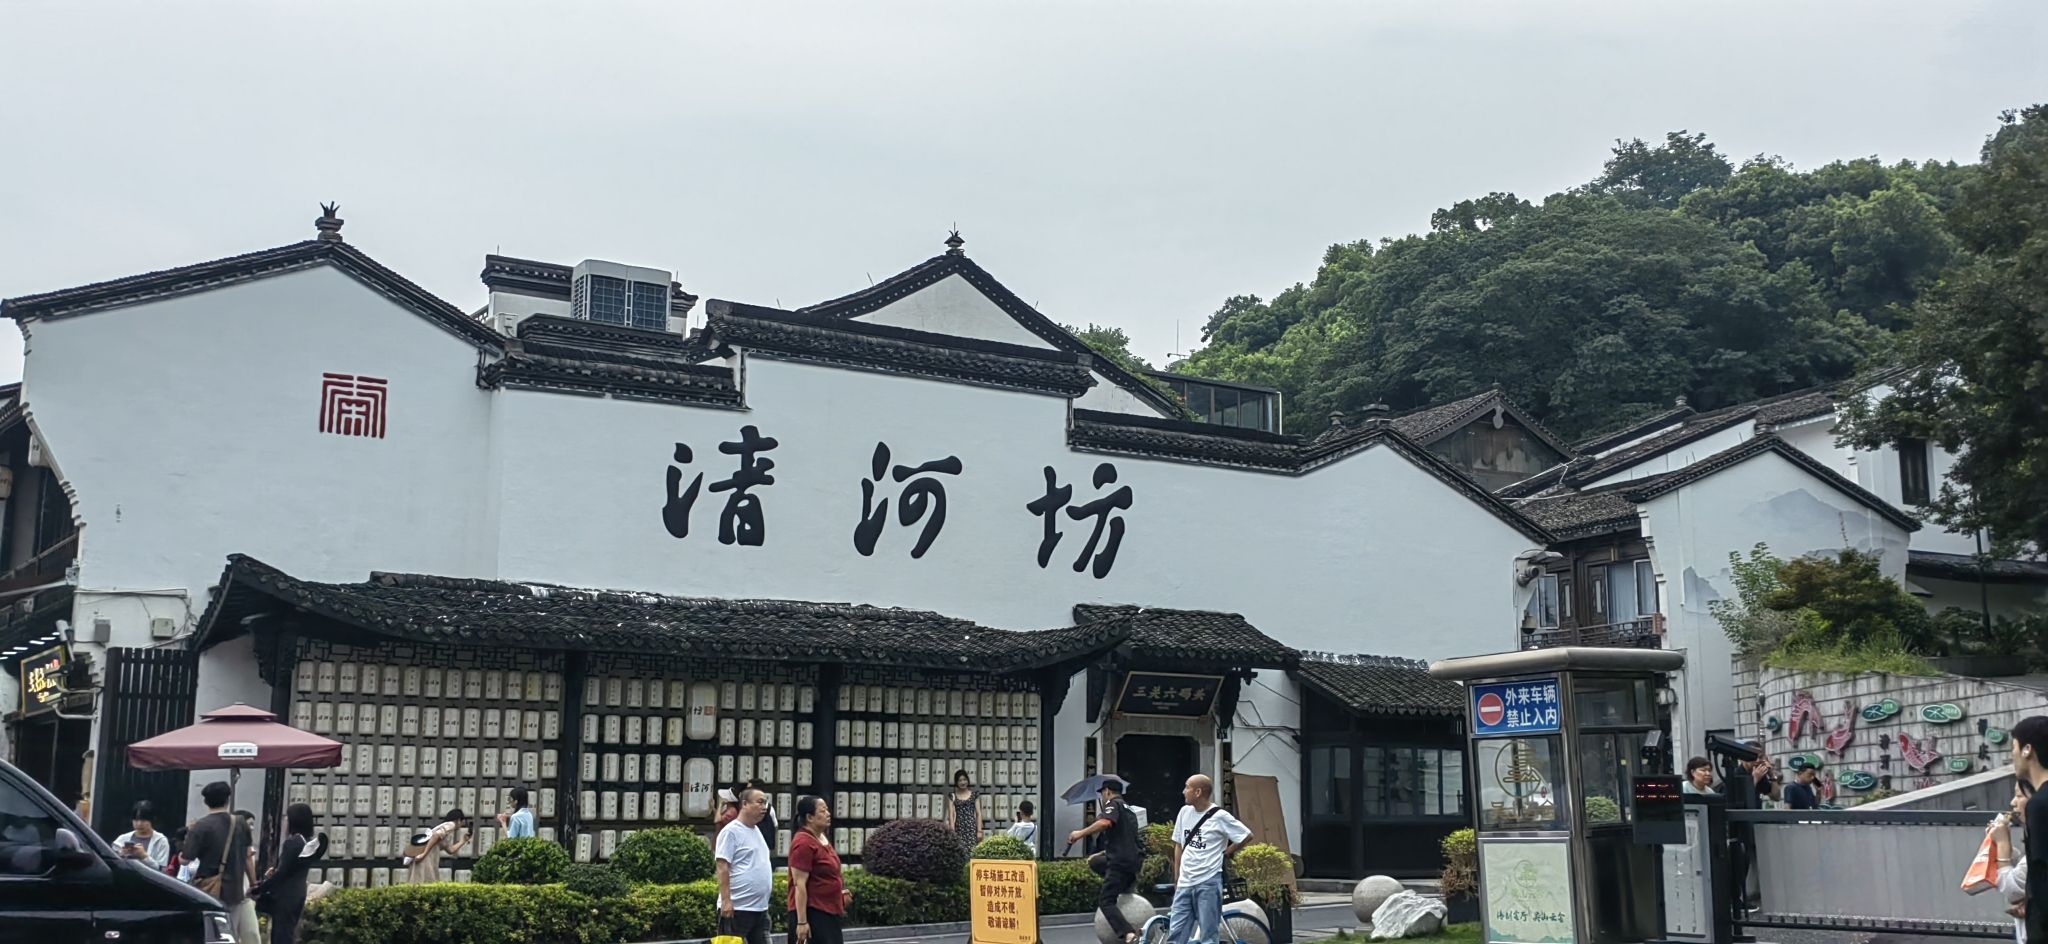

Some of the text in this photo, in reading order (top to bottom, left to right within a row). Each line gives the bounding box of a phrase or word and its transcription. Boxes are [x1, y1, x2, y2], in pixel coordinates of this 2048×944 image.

[662, 425, 1133, 579] 清河坊
[1505, 685, 1556, 706] 外来车辆
[1506, 706, 1557, 728] 禁止入内
[690, 782, 713, 793] 清河
